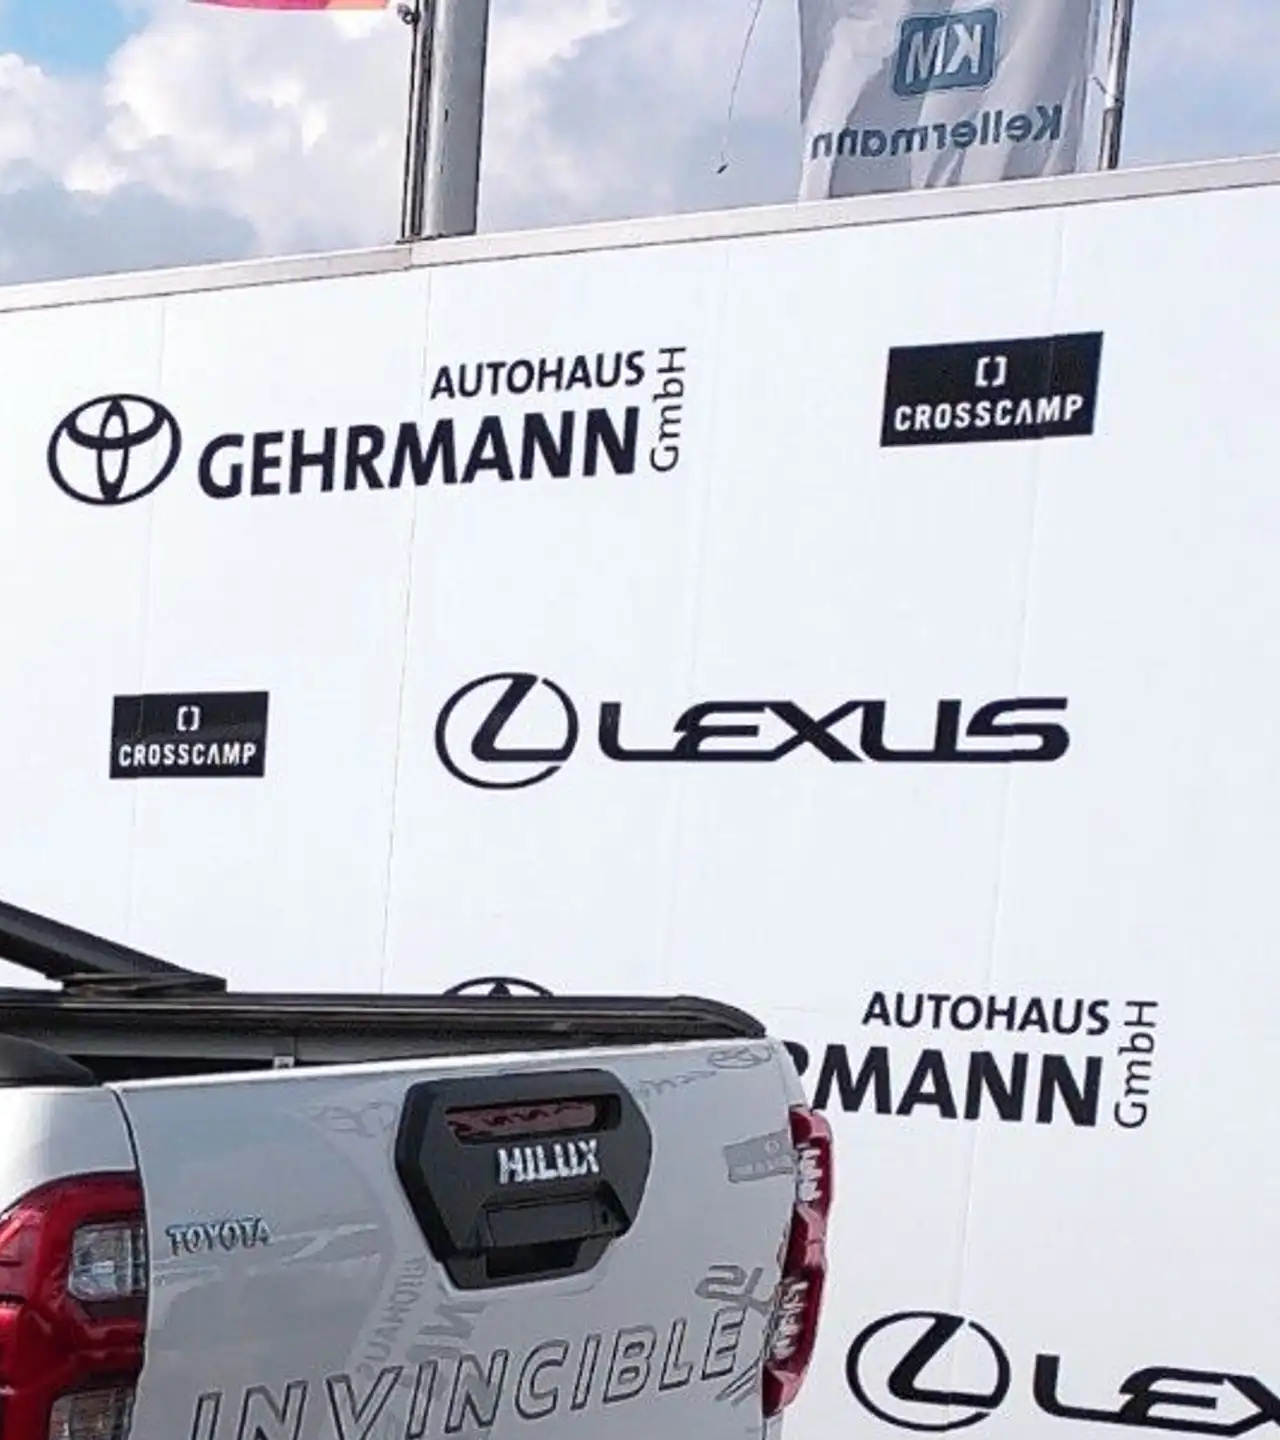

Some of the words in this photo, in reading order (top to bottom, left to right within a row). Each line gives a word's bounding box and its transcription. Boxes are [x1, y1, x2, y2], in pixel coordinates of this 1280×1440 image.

[431, 350, 645, 400] AUTOHAUS
[649, 346, 687, 473] GmbH
[894, 394, 1084, 432] CROSSCAMP
[197, 406, 640, 500] GEHRMANN
[118, 741, 257, 767] CROSSCAMP
[598, 697, 1070, 763] LEXUS
[861, 991, 1110, 1036] AUTOHAUS
[1113, 1000, 1159, 1129] GmbH
[497, 1138, 600, 1185] HILUX
[164, 1215, 271, 1256] TOYOTA
